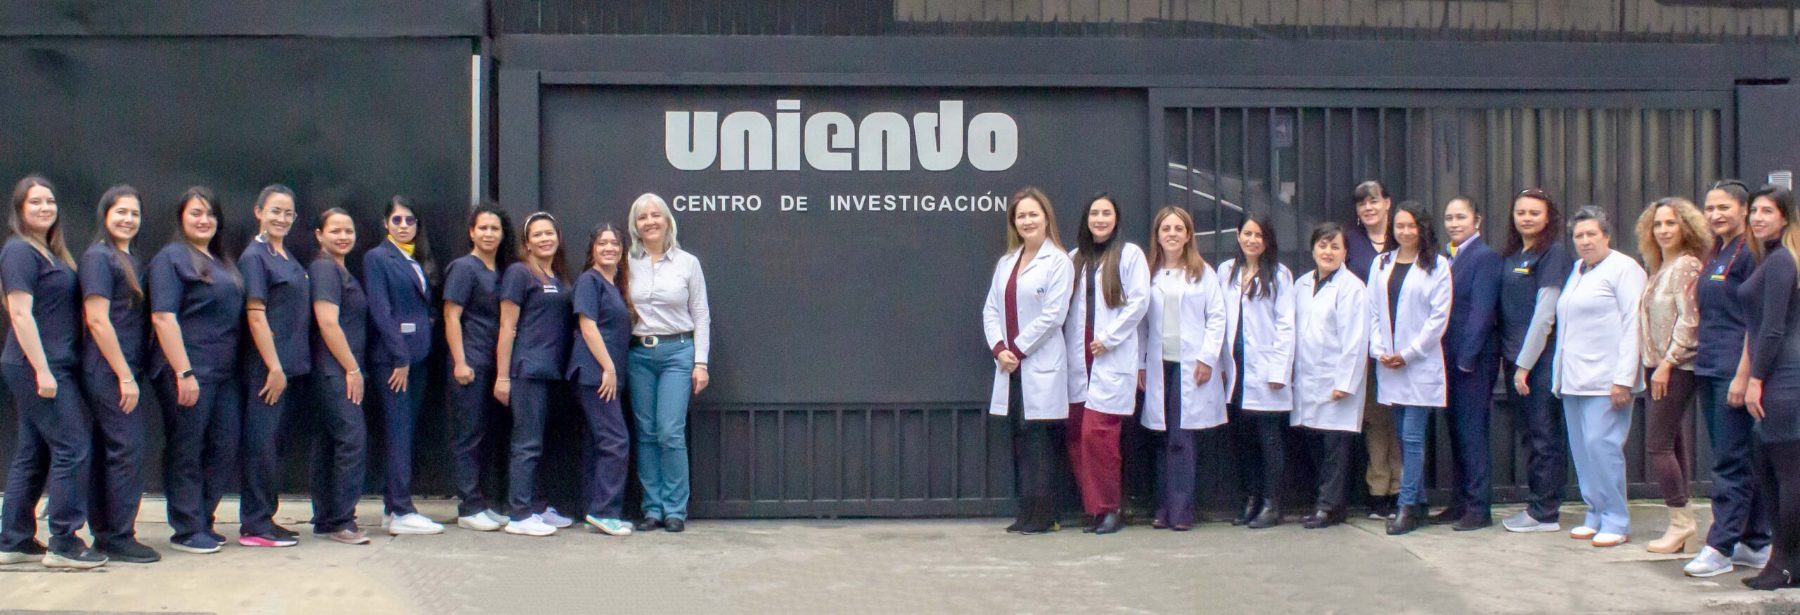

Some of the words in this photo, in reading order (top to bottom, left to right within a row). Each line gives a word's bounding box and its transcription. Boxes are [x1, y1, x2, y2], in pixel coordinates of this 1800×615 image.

[665, 99, 1018, 172] uniendo
[672, 194, 762, 212] CENTRO
[780, 195, 808, 211] DE
[830, 190, 1007, 212] INVESTIGACIÓN
